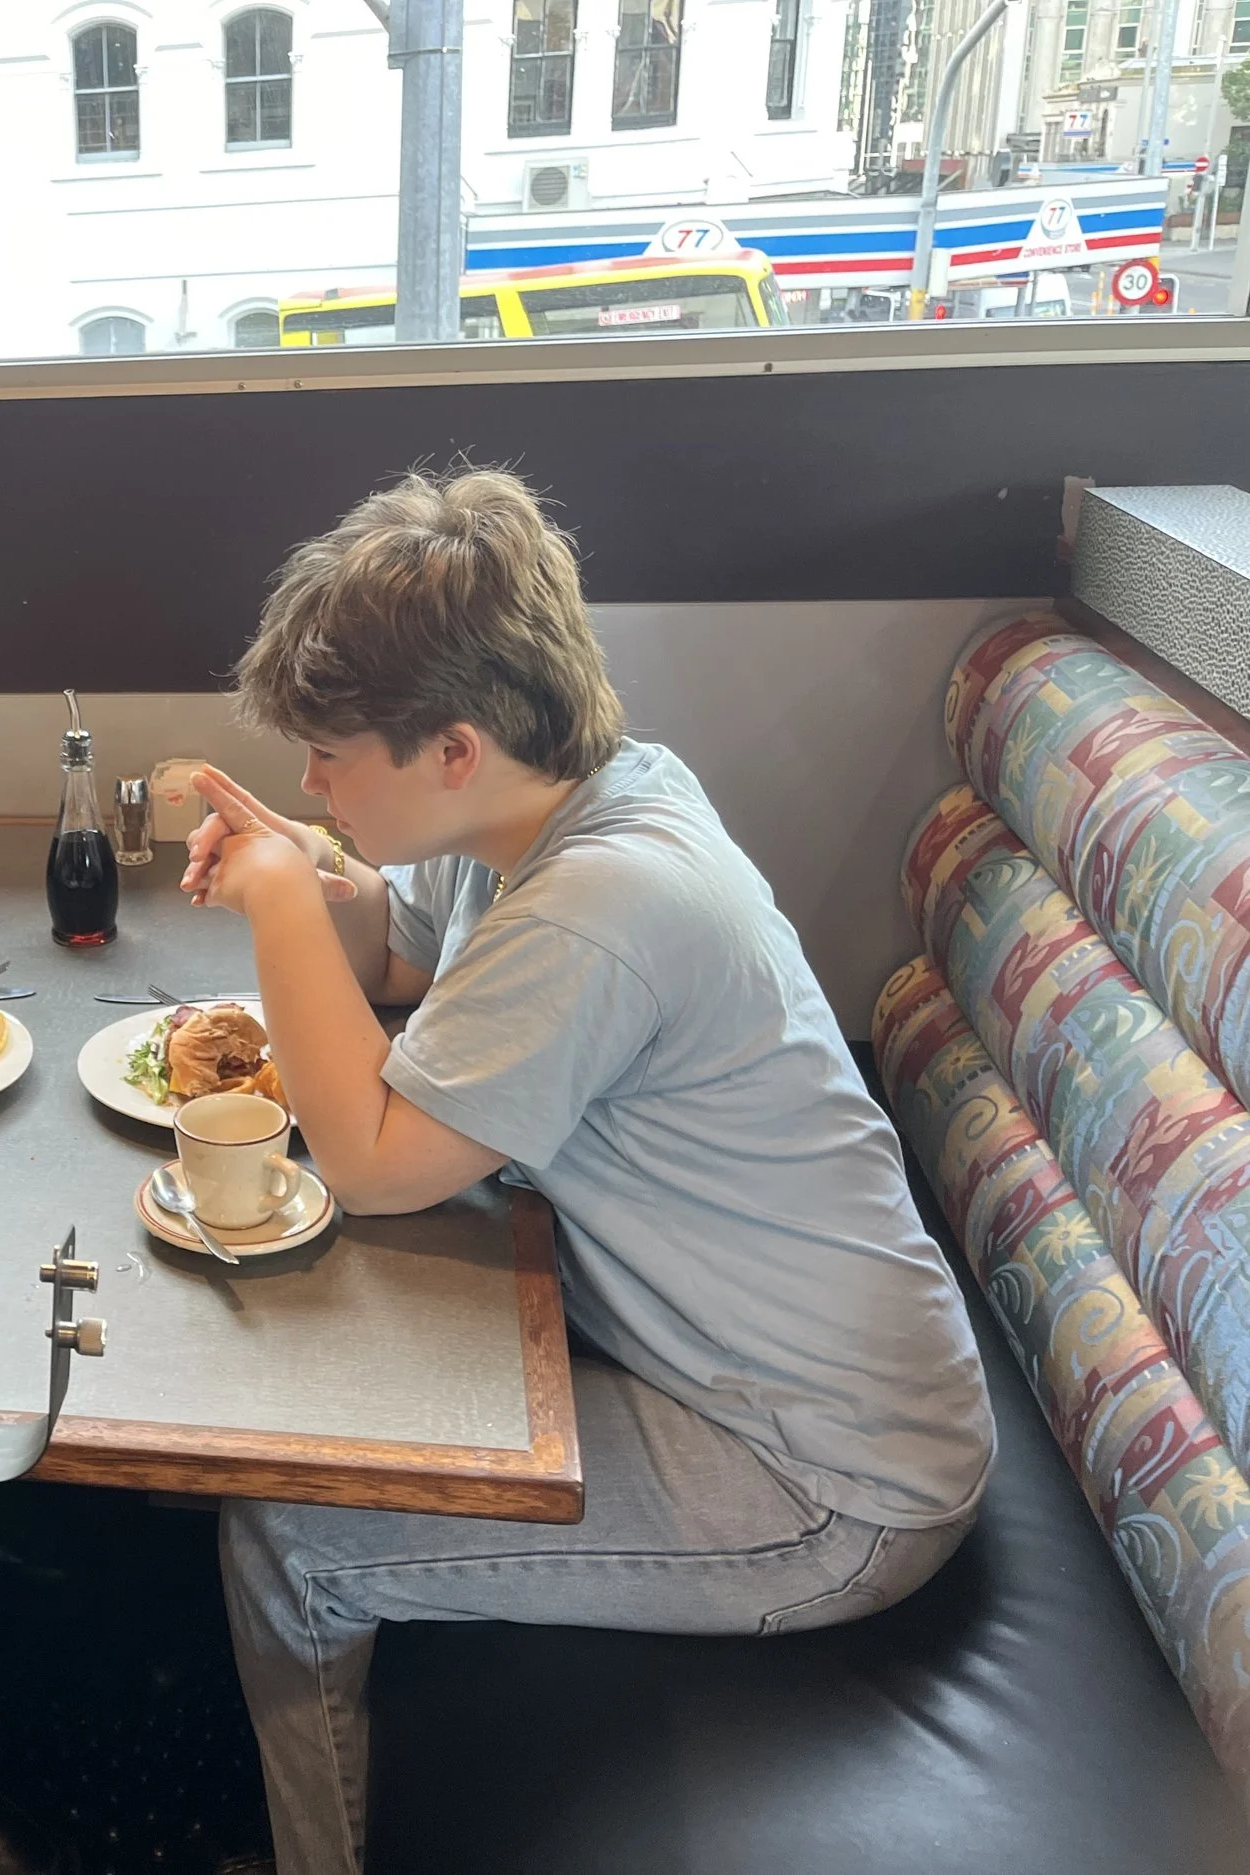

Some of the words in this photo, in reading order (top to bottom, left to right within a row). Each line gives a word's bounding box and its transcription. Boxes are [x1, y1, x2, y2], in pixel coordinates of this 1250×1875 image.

[1068, 114, 1088, 128] 77
[1048, 206, 1066, 225] 77
[677, 229, 710, 249] 77
[1123, 273, 1148, 290] 30
